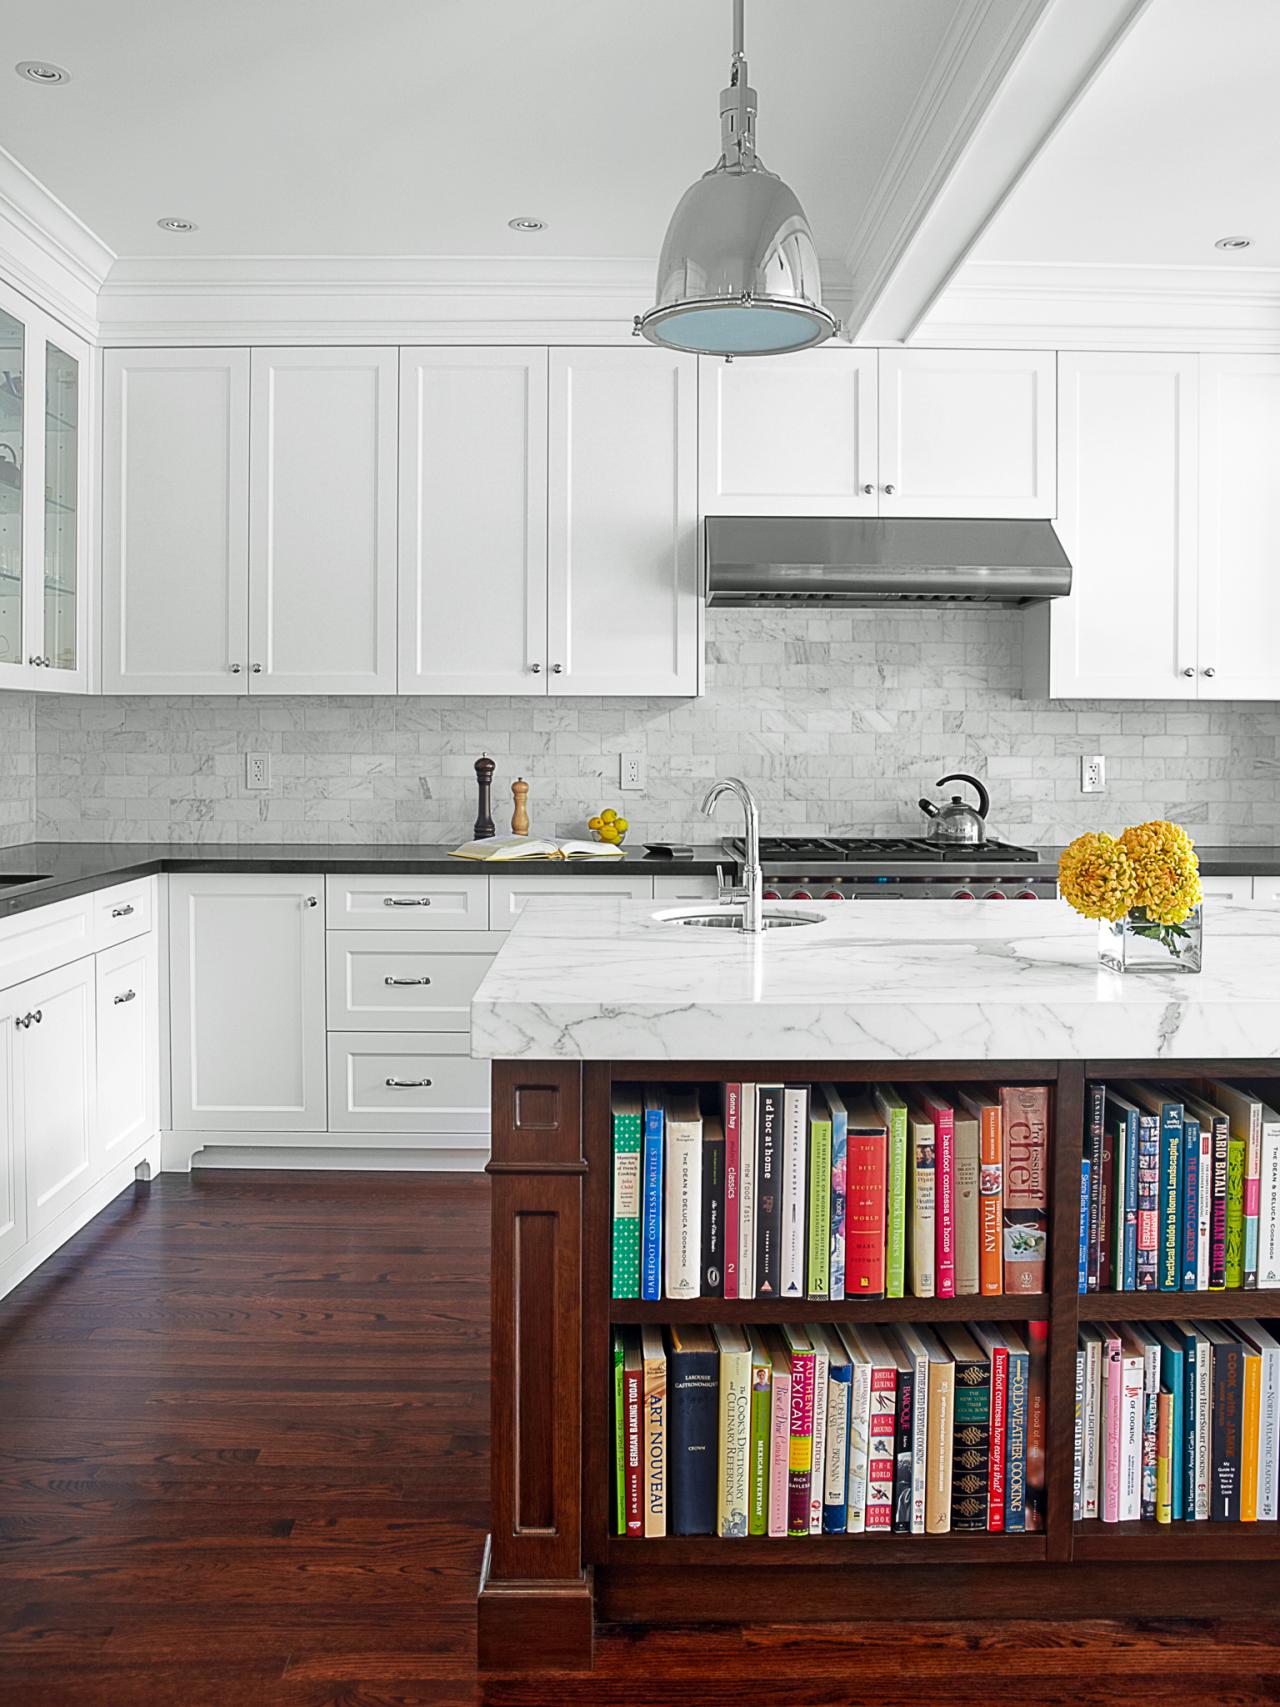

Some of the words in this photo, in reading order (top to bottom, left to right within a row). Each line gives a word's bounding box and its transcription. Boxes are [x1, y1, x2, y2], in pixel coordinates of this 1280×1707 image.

[765, 1098, 773, 1112] ad
[1092, 1095, 1101, 1135] CANADIAN
[727, 1116, 736, 1129] hay
[765, 1114, 774, 1134] hoc
[894, 1116, 904, 1153] barefoot
[764, 1136, 772, 1148] at
[942, 1135, 951, 1173] barefoot
[1091, 1137, 1100, 1171] LIVING'S
[1215, 1124, 1228, 1158] MARIO
[650, 1147, 658, 1186] PARTIES!
[764, 1150, 773, 1179] home
[893, 1155, 903, 1194] contessa
[1008, 1121, 1044, 1200] chef
[1031, 1121, 1045, 1200] Professional
[1168, 1138, 1179, 1190] Landscaping
[1188, 1157, 1197, 1172] THE
[728, 1167, 736, 1199] classics
[744, 1182, 752, 1200] food
[821, 1183, 826, 1192] OF
[943, 1174, 951, 1214] contessa
[1091, 1174, 1099, 1201] FAMILY
[1187, 1173, 1197, 1219] RELUCTANT
[1214, 1162, 1227, 1197] BATALI
[649, 1190, 657, 1238] CONTESSA
[743, 1205, 751, 1223] fast
[893, 1195, 902, 1217] back
[1168, 1190, 1177, 1213] Home
[893, 1219, 901, 1229] to
[943, 1216, 951, 1226] at
[984, 1200, 996, 1252] ITALIAN
[1090, 1204, 1098, 1244] COOKBOOK
[1142, 1212, 1151, 1246] WOMEN
[1168, 1215, 1176, 1223] to
[1213, 1200, 1226, 1240] ITALIAN
[893, 1231, 902, 1256] basics
[943, 1228, 951, 1253] home
[1166, 1224, 1176, 1248] Guide
[1186, 1221, 1196, 1262] GARDENER
[648, 1242, 656, 1293] BAREFOOT
[728, 1264, 734, 1273] 2
[1165, 1249, 1176, 1286] Practical
[1213, 1244, 1224, 1273] GRILL
[916, 1361, 926, 1406] LIGHTHEARTED
[995, 1355, 1003, 1390] barefoot
[1199, 1372, 1207, 1396] SIMPLY
[1228, 1353, 1237, 1387] COOK
[629, 1378, 638, 1404] TODAY
[776, 1386, 788, 1404] Rise
[792, 1360, 804, 1431] MEXICAN
[804, 1361, 813, 1430] AUTHENTIC
[816, 1382, 824, 1416] LINDSAY'S
[1125, 1385, 1142, 1398] joy
[1129, 1400, 1136, 1409] OF
[1227, 1392, 1236, 1416] with
[1266, 1392, 1274, 1419] NORTH
[629, 1405, 638, 1433] BAKING
[650, 1394, 662, 1427] ART
[726, 1392, 736, 1445] CULINARY
[736, 1396, 747, 1435] COOK'S
[776, 1414, 787, 1434] Dine
[902, 1386, 911, 1430] BAROQUE
[916, 1407, 926, 1437] EVERYDAY
[995, 1391, 1003, 1427] contessa
[1148, 1394, 1157, 1433] EVERYDAY
[815, 1417, 823, 1440] LIGHT
[994, 1428, 1002, 1445] how
[1034, 1430, 1040, 1438] of
[1088, 1414, 1096, 1436] LIGHT
[1226, 1422, 1235, 1456] JAMIE
[1265, 1421, 1273, 1458] ATLANTIC
[630, 1434, 638, 1467] GERMAN
[774, 1435, 786, 1466] Canada
[814, 1442, 822, 1473] KITCHEN
[831, 1447, 840, 1482] BRENNAN
[916, 1437, 925, 1464] COOKING
[991, 1445, 1001, 1463] easy
[1147, 1434, 1156, 1466] ITALIAN
[1198, 1445, 1206, 1478] COOKING
[651, 1432, 663, 1514] NOUVEAU
[726, 1447, 735, 1506] REFERENCE
[736, 1437, 746, 1500] DICTIONARY
[993, 1472, 1002, 1493] that?
[1264, 1460, 1272, 1494] SEAFOOD
[1011, 1461, 1022, 1512] COOKING
